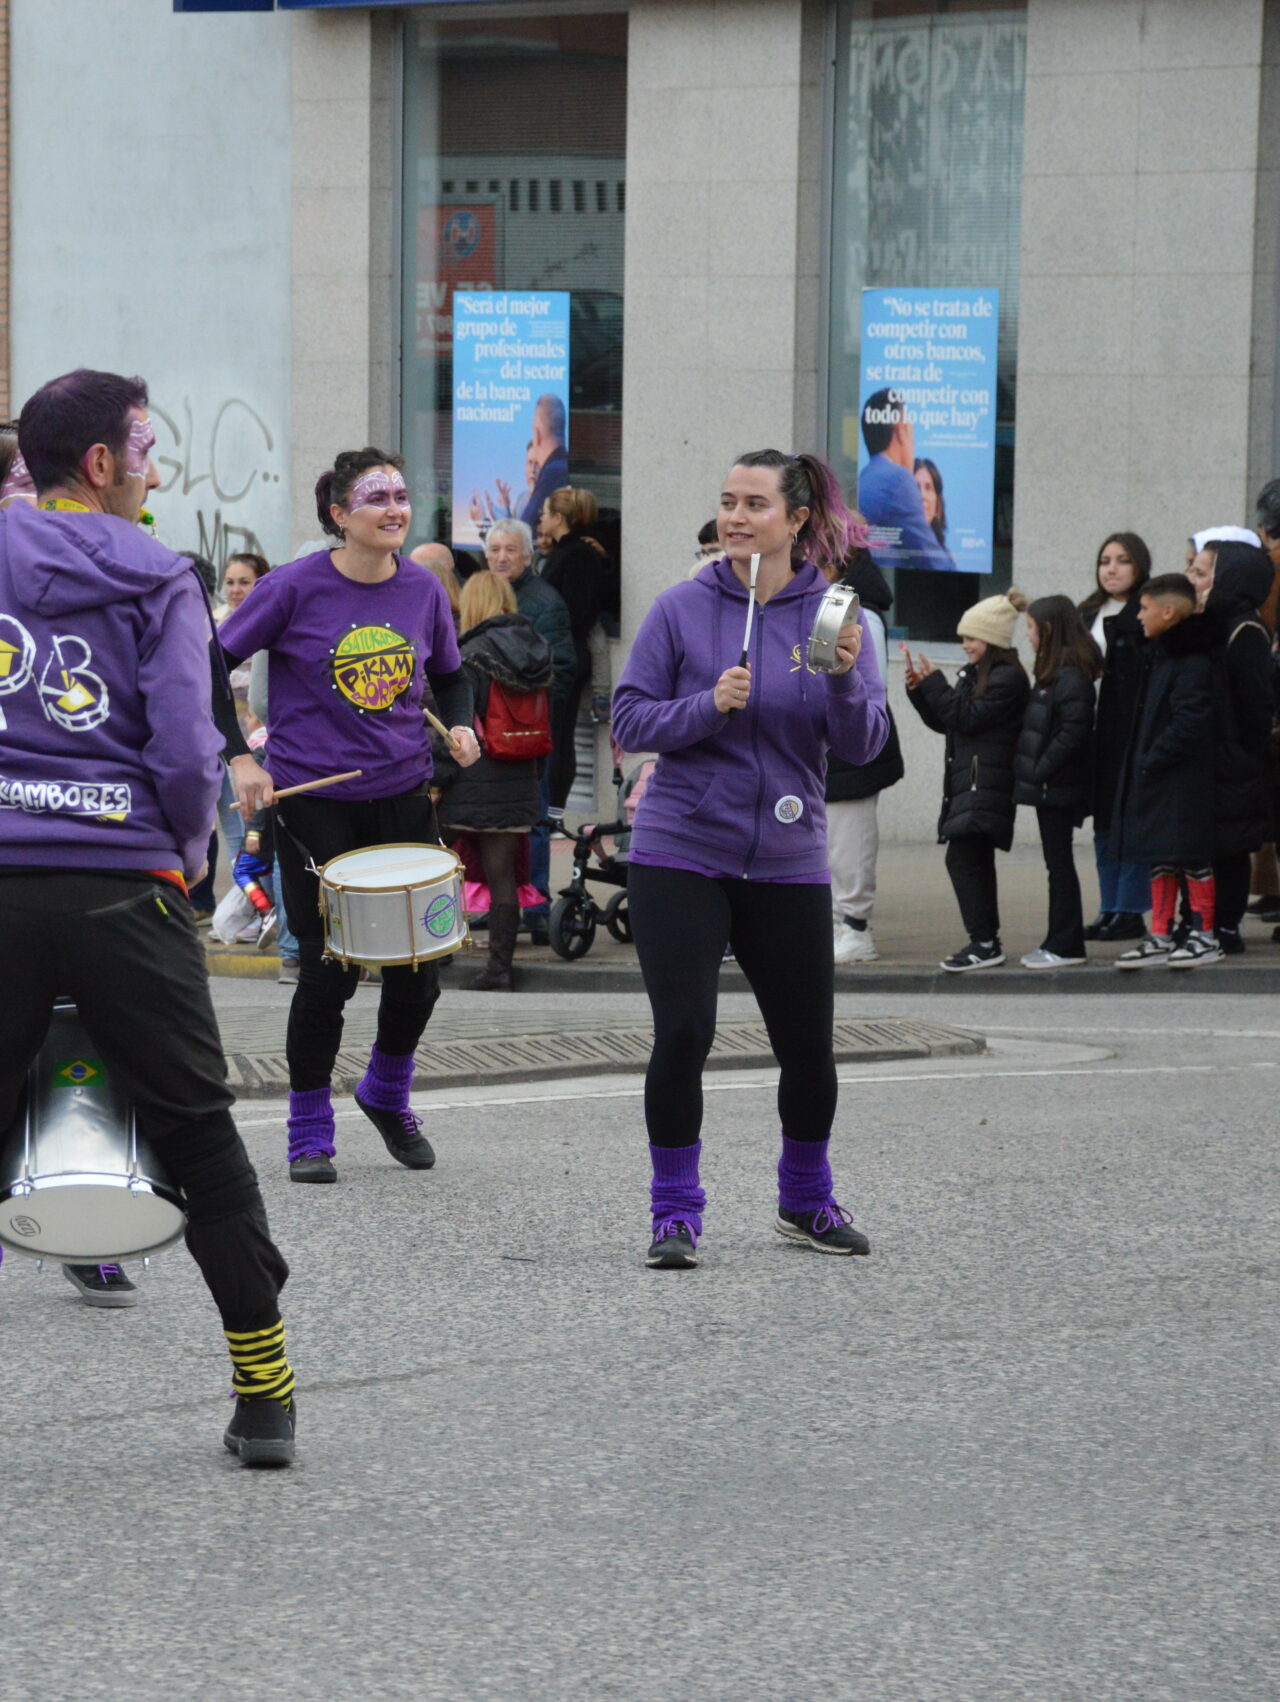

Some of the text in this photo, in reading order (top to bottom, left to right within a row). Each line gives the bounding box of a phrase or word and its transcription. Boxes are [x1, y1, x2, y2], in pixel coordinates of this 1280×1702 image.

[495, 295, 507, 314] el
[510, 295, 550, 318] mejor
[915, 301, 930, 317] se
[933, 299, 970, 317] trata
[972, 296, 993, 318] de
[457, 320, 498, 341] grupo
[499, 317, 517, 337] de
[867, 318, 968, 343] competir con
[474, 339, 566, 362] profesionales
[884, 340, 986, 363] otros bancos,
[501, 360, 522, 379] del
[524, 363, 566, 380] sector
[866, 365, 882, 381] se
[885, 364, 922, 381] trata
[923, 361, 943, 382] de
[456, 380, 531, 401] de la banca
[887, 384, 990, 408] competir con
[864, 403, 900, 424] todo
[902, 405, 918, 425] lo
[920, 409, 948, 431] que
